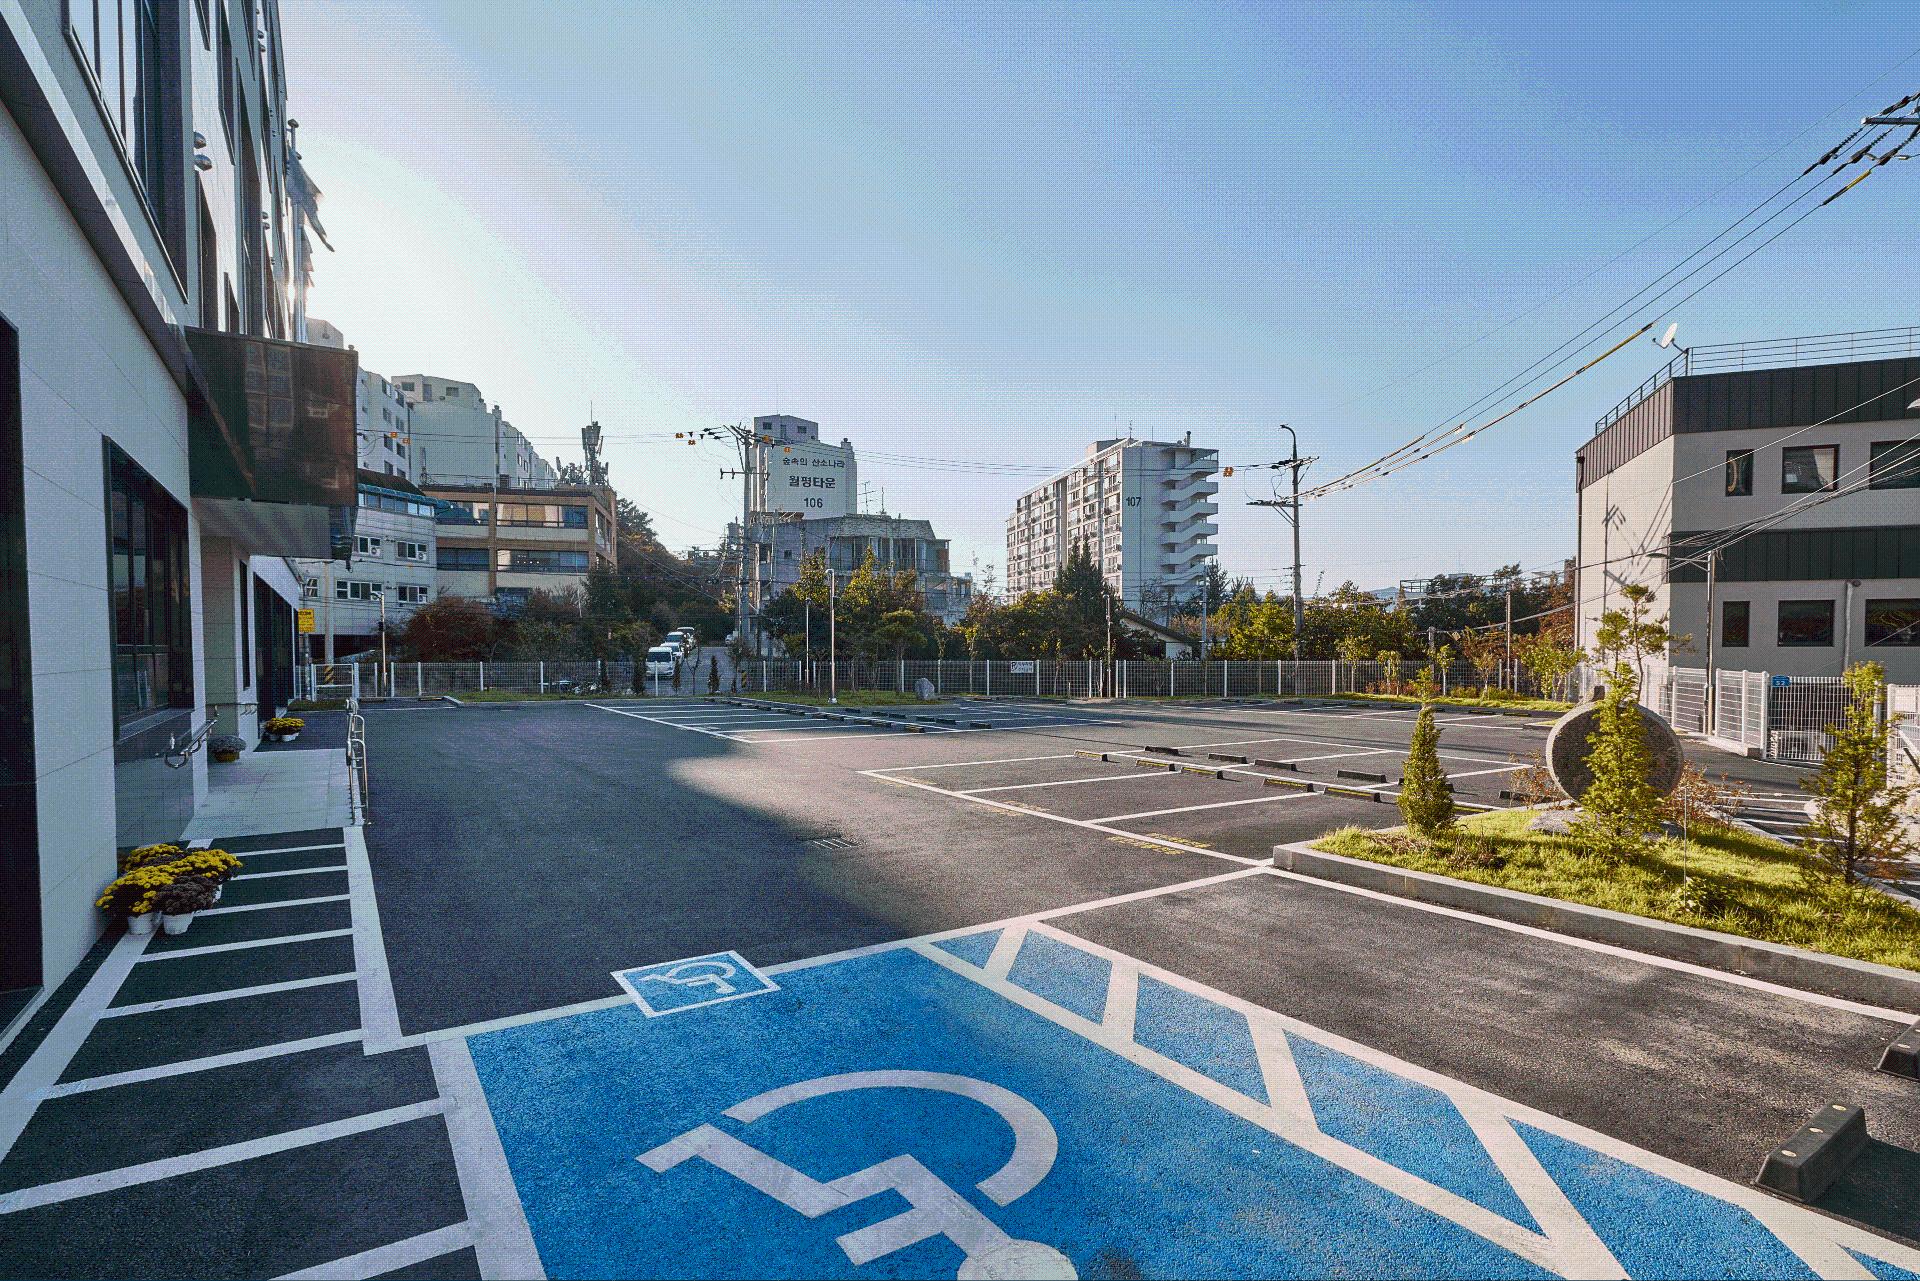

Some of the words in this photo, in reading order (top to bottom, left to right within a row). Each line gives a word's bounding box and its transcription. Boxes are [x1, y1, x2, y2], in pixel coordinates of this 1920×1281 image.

[812, 458, 845, 468] 산소나라
[789, 475, 836, 488] 월평타운
[803, 497, 823, 508] 106
[1126, 496, 1141, 507] 107
